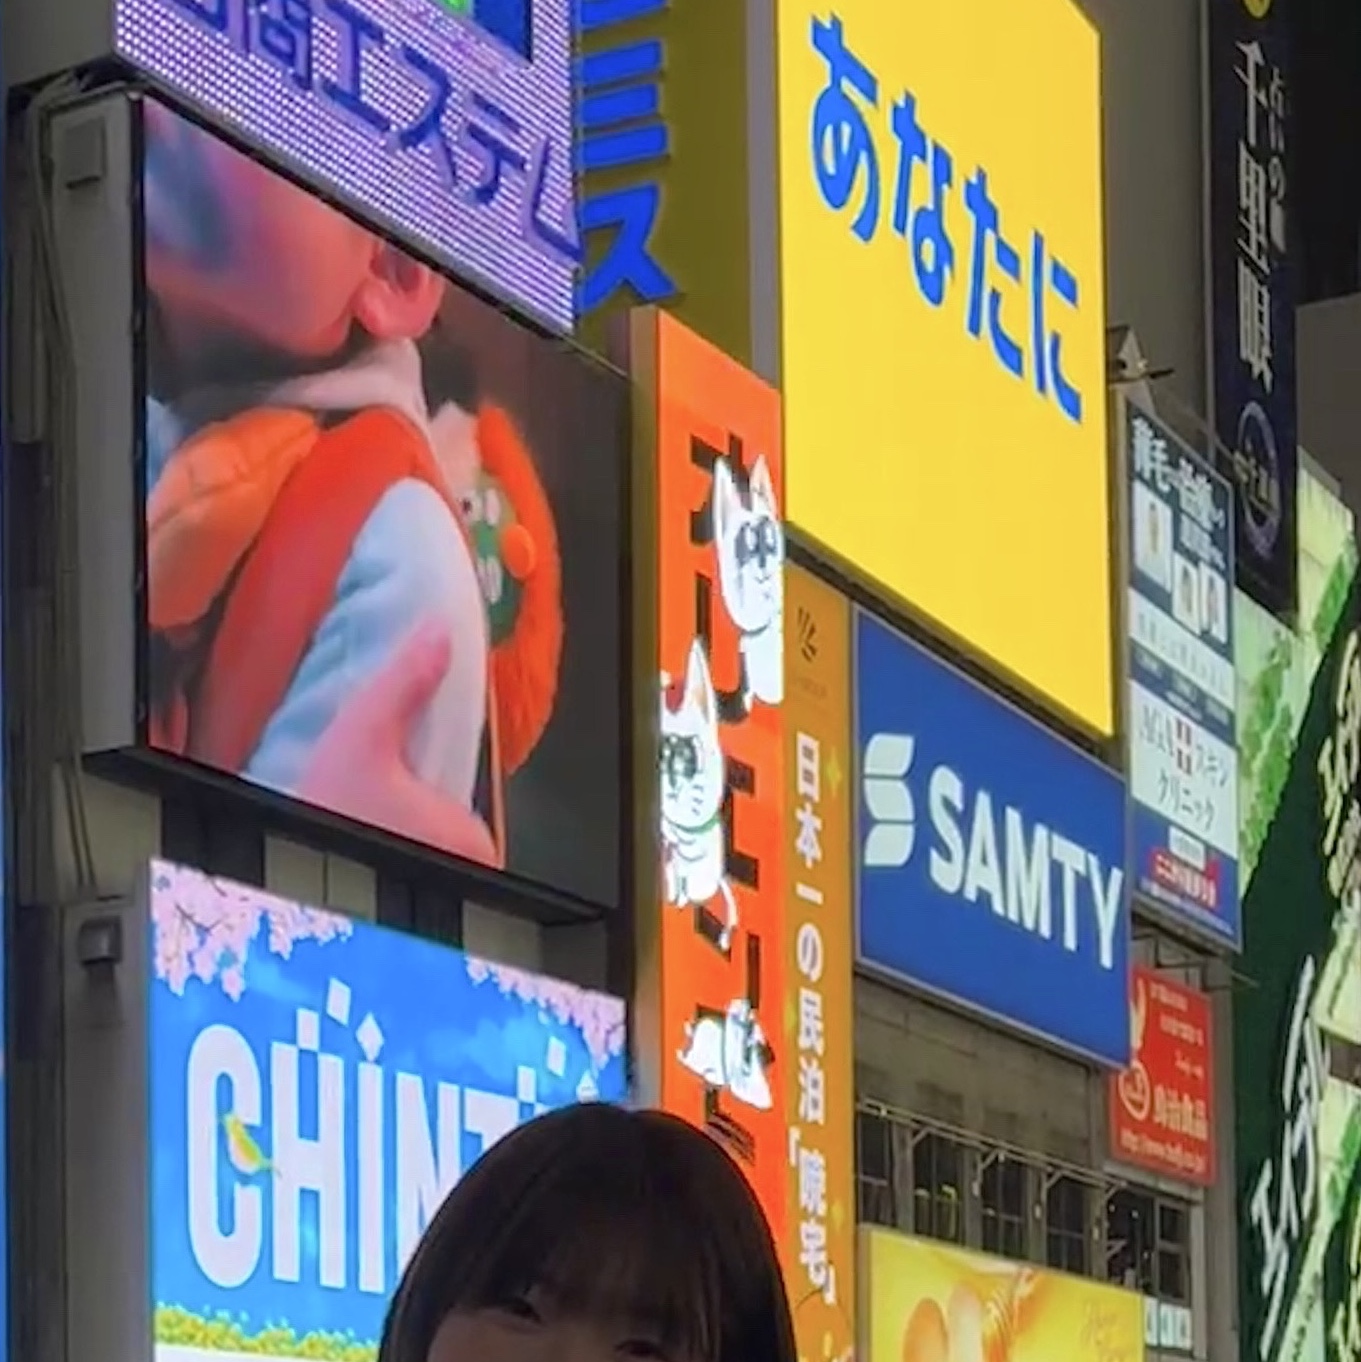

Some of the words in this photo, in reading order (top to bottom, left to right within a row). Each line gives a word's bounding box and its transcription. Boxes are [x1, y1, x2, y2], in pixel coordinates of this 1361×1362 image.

[811, 12, 1082, 424] あなたに
[1234, 40, 1274, 396] 千里眼
[928, 763, 1124, 970] SAMTY
[187, 978, 598, 1293] CHIN
